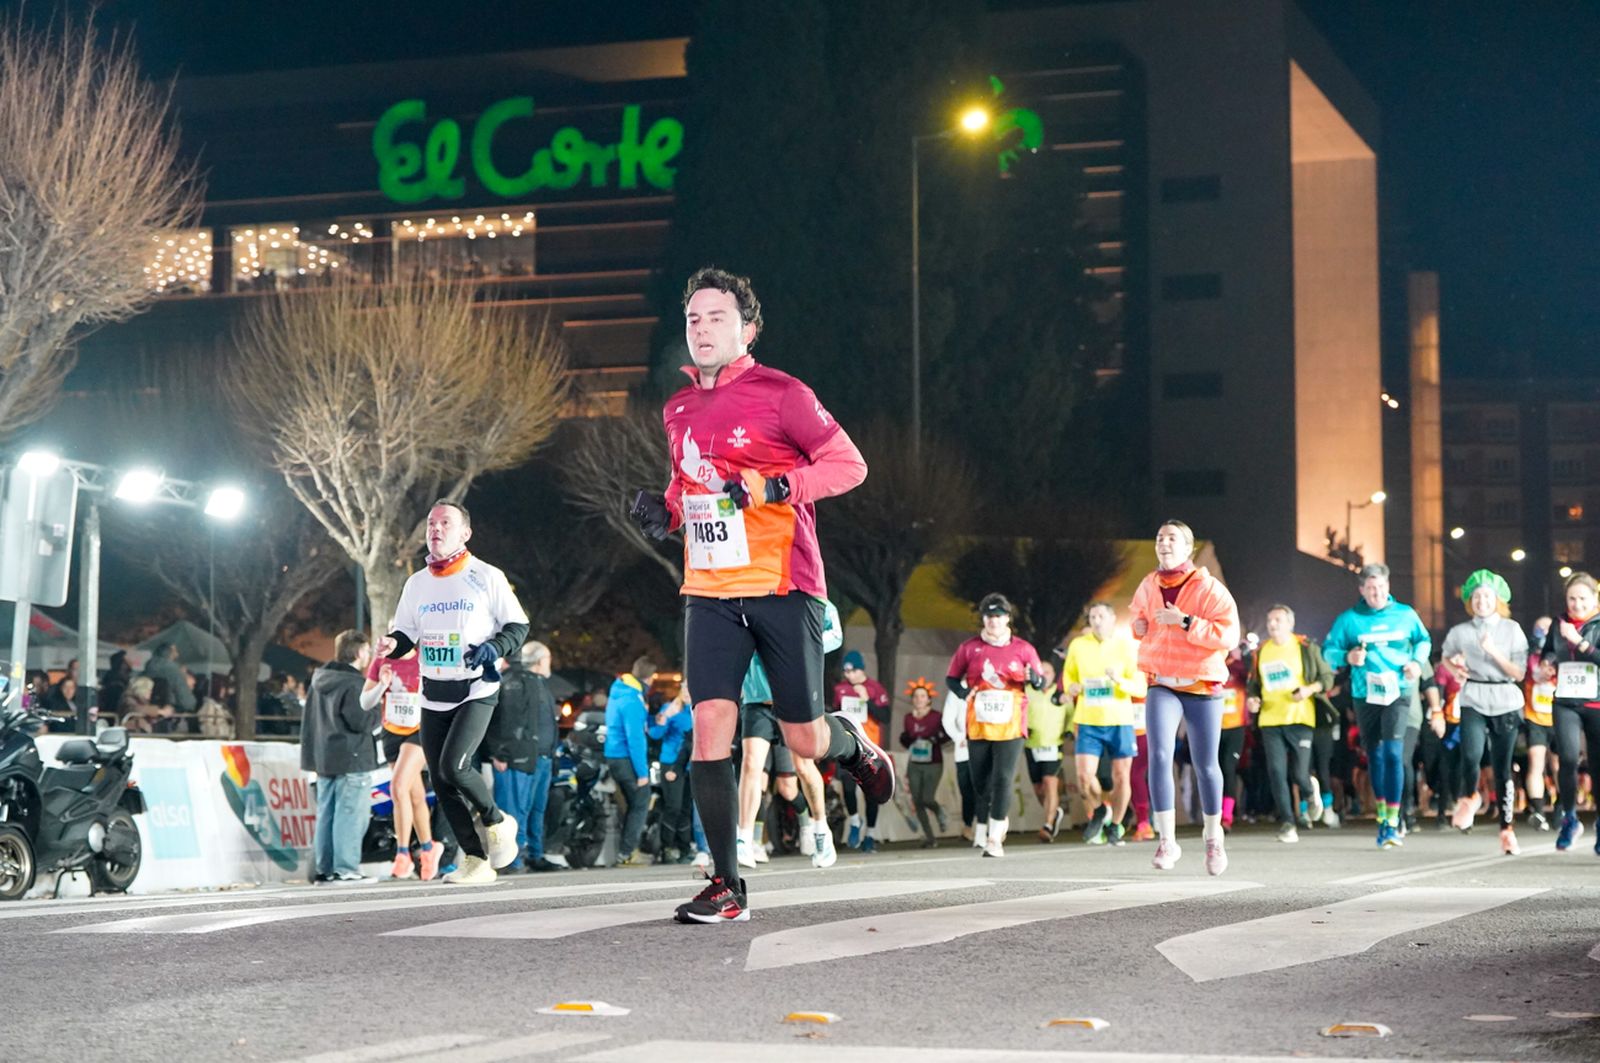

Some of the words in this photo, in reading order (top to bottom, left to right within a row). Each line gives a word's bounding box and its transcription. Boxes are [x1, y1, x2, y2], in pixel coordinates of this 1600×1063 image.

[372, 98, 466, 203] El
[471, 95, 686, 196] Corte
[430, 599, 474, 615] aqualia
[424, 646, 454, 662] 13171
[1567, 675, 1587, 686] 538
[394, 704, 414, 716] 1196
[269, 777, 308, 810] SAN
[151, 800, 191, 829] alsa
